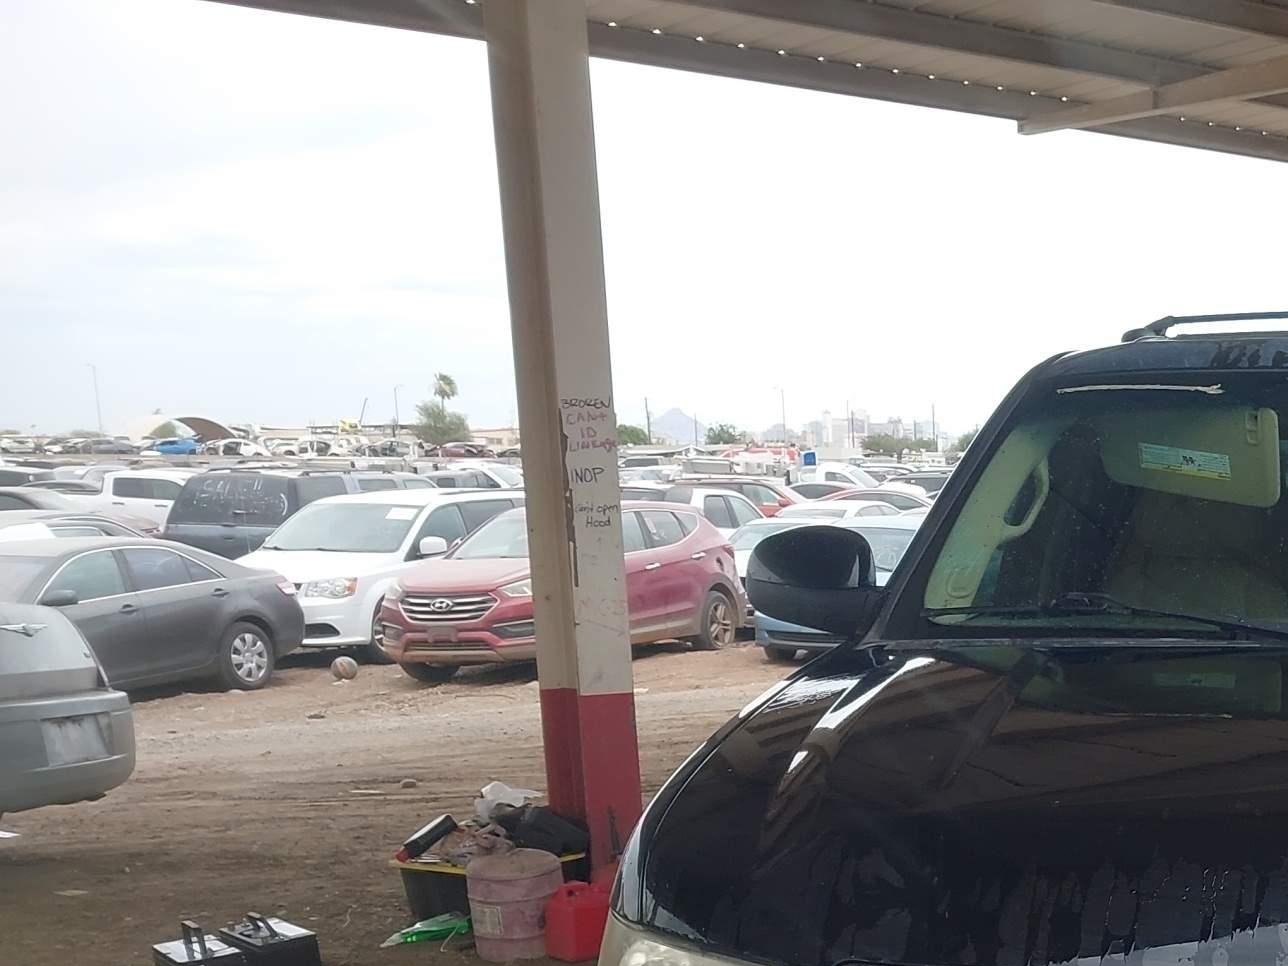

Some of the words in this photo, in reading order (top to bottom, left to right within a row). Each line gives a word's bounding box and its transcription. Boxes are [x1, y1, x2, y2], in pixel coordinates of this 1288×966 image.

[580, 427, 597, 438] ID
[570, 467, 605, 484] INOP
[585, 516, 611, 528] Hood
